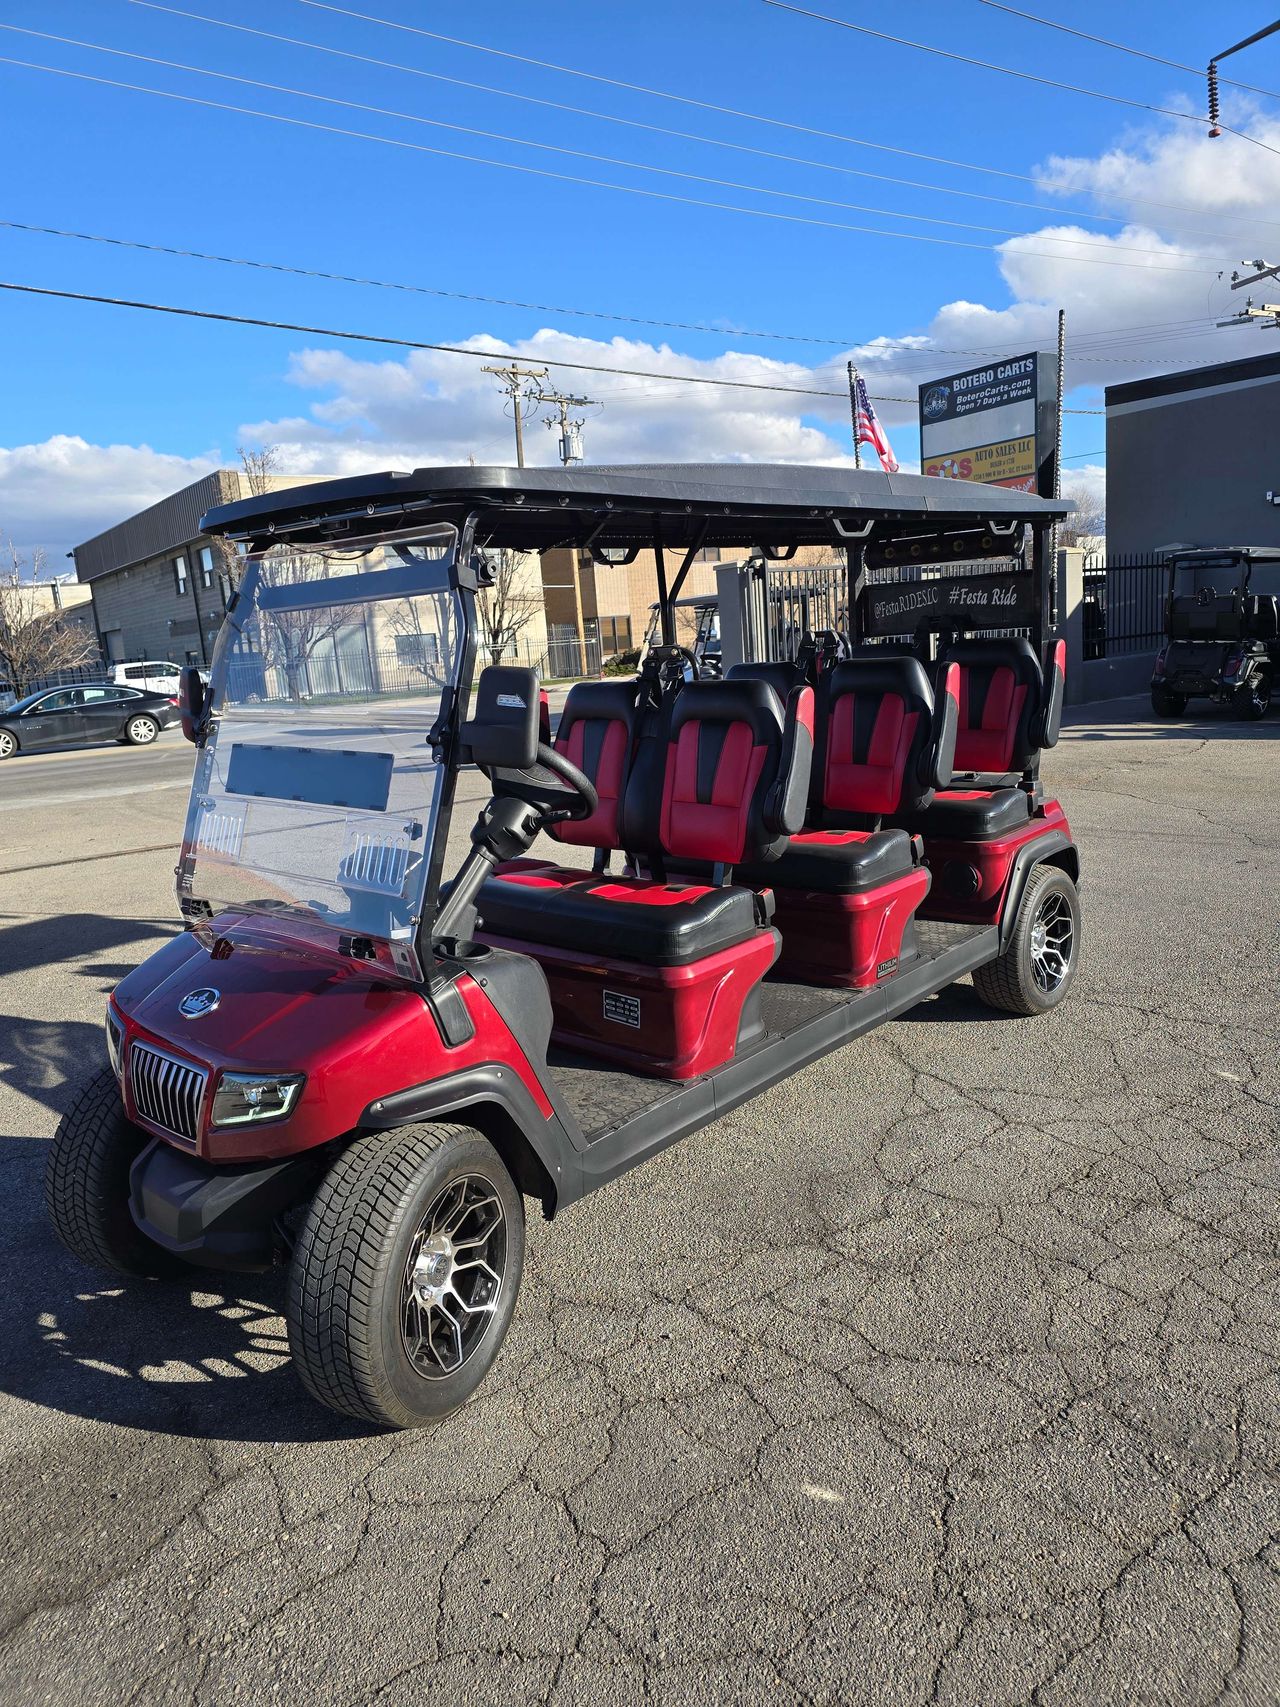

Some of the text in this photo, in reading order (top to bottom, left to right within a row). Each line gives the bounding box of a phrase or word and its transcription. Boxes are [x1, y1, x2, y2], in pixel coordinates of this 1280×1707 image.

[953, 359, 1034, 391] BOTERO CARTS
[956, 402, 975, 413] Open
[983, 395, 1001, 405] Days
[1010, 386, 1032, 398] Week
[957, 379, 1031, 404] BoteroCarts.com
[975, 440, 1032, 462] AUTO SALES LLC
[874, 587, 939, 620] @FestaRIDESLC
[949, 585, 1017, 606] #Festa Ride
